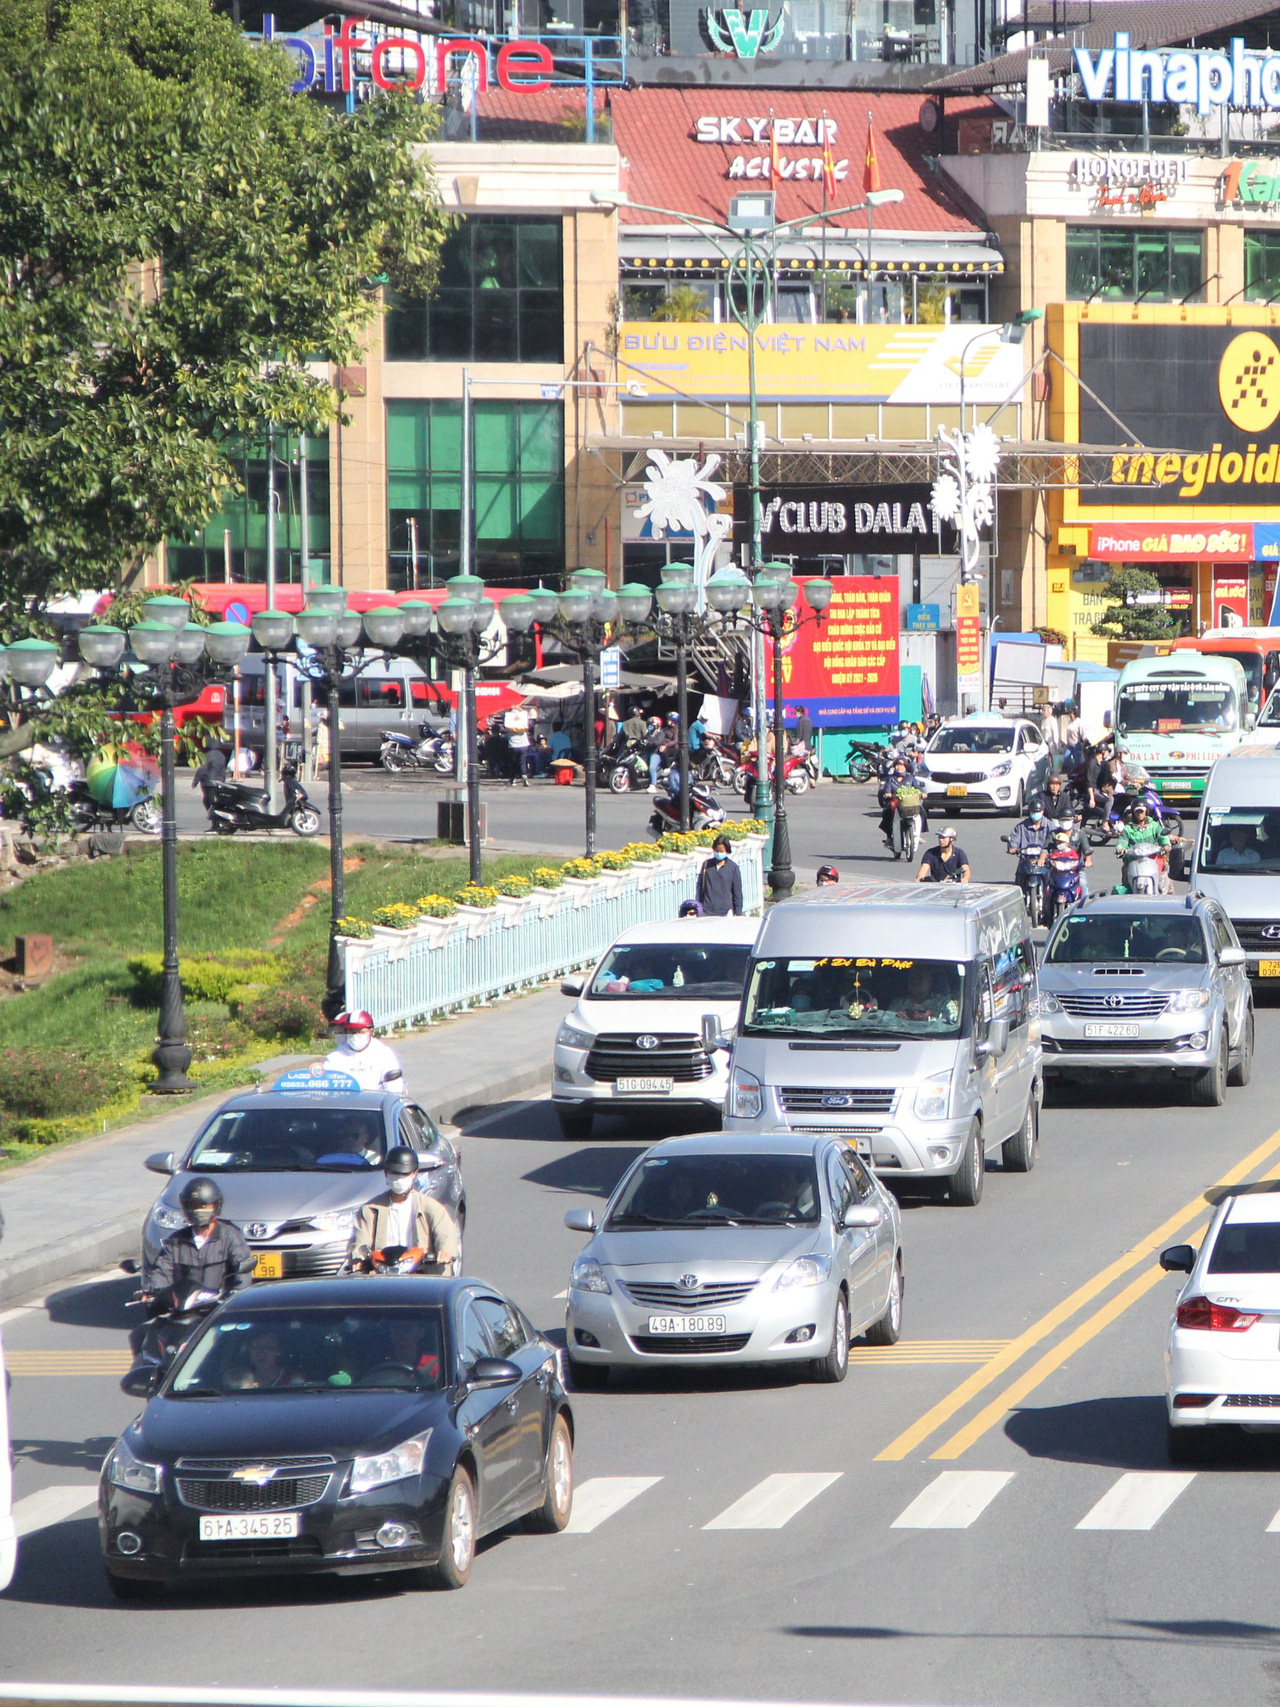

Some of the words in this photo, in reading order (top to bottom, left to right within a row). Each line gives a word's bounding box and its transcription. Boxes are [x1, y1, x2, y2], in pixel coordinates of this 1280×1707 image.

[263, 13, 554, 94] bifone
[729, 155, 848, 179] ACUSTC
[1076, 158, 1188, 184] HONOLULU
[625, 332, 678, 350] BƯU
[687, 333, 747, 353] ĐIỆN
[756, 332, 805, 353] VIỆT
[815, 337, 867, 351] NAM
[1097, 537, 1140, 551] iPhone
[1141, 534, 1168, 552] GIÁ
[332, 1080, 352, 1088] 777
[828, 1097, 845, 1105] Ford
